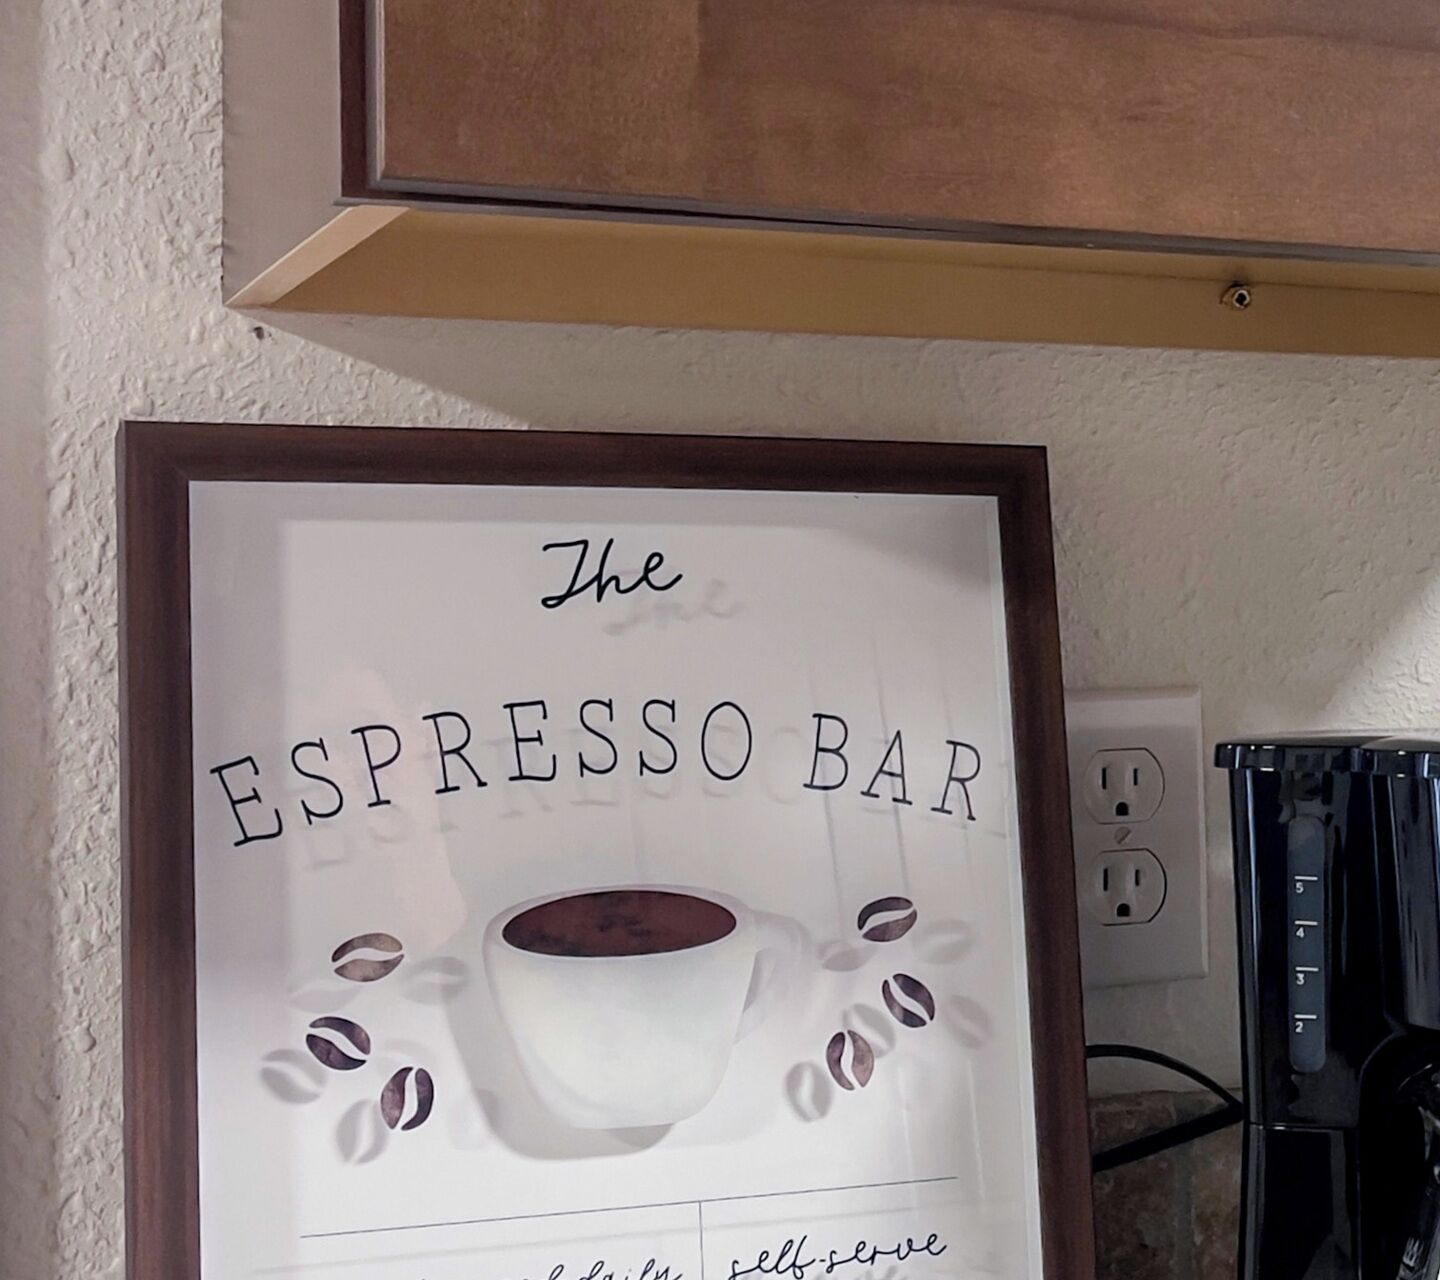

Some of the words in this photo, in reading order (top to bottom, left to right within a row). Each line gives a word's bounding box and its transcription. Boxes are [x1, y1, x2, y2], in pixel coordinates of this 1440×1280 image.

[540, 538, 683, 609] The
[210, 699, 753, 847] ESPRESSO
[803, 712, 982, 821] BAR
[1295, 881, 1304, 894] 5
[1295, 926, 1305, 938] 4
[1295, 972, 1305, 985] 3
[1295, 1021, 1304, 1033] 2
